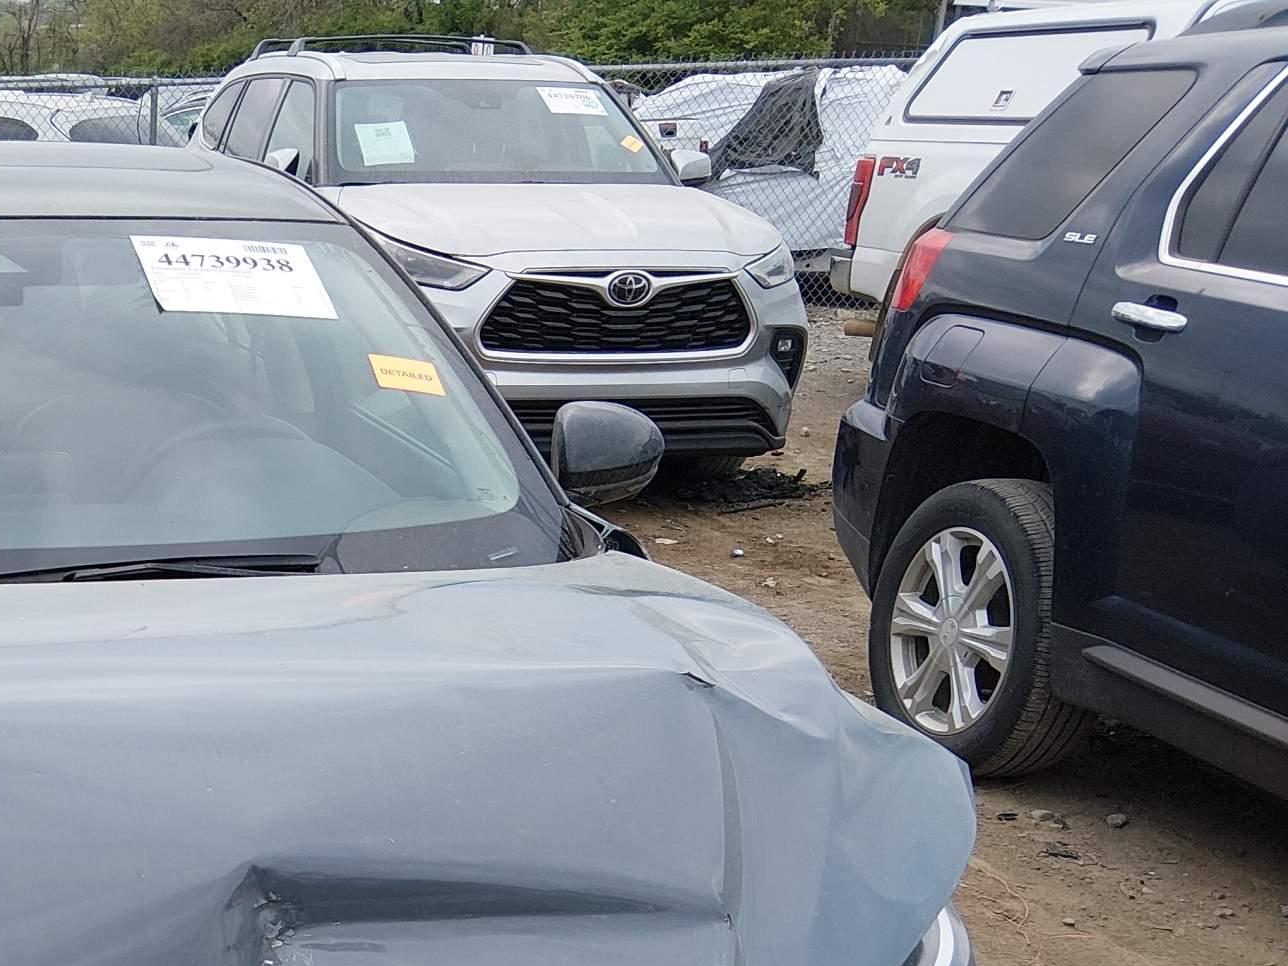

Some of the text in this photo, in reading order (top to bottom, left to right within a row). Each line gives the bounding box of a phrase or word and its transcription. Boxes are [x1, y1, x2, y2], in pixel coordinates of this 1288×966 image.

[877, 156, 922, 176] FX4
[1063, 232, 1097, 244] SLE
[157, 253, 295, 273] 44739938
[379, 367, 433, 381] DETAILED
